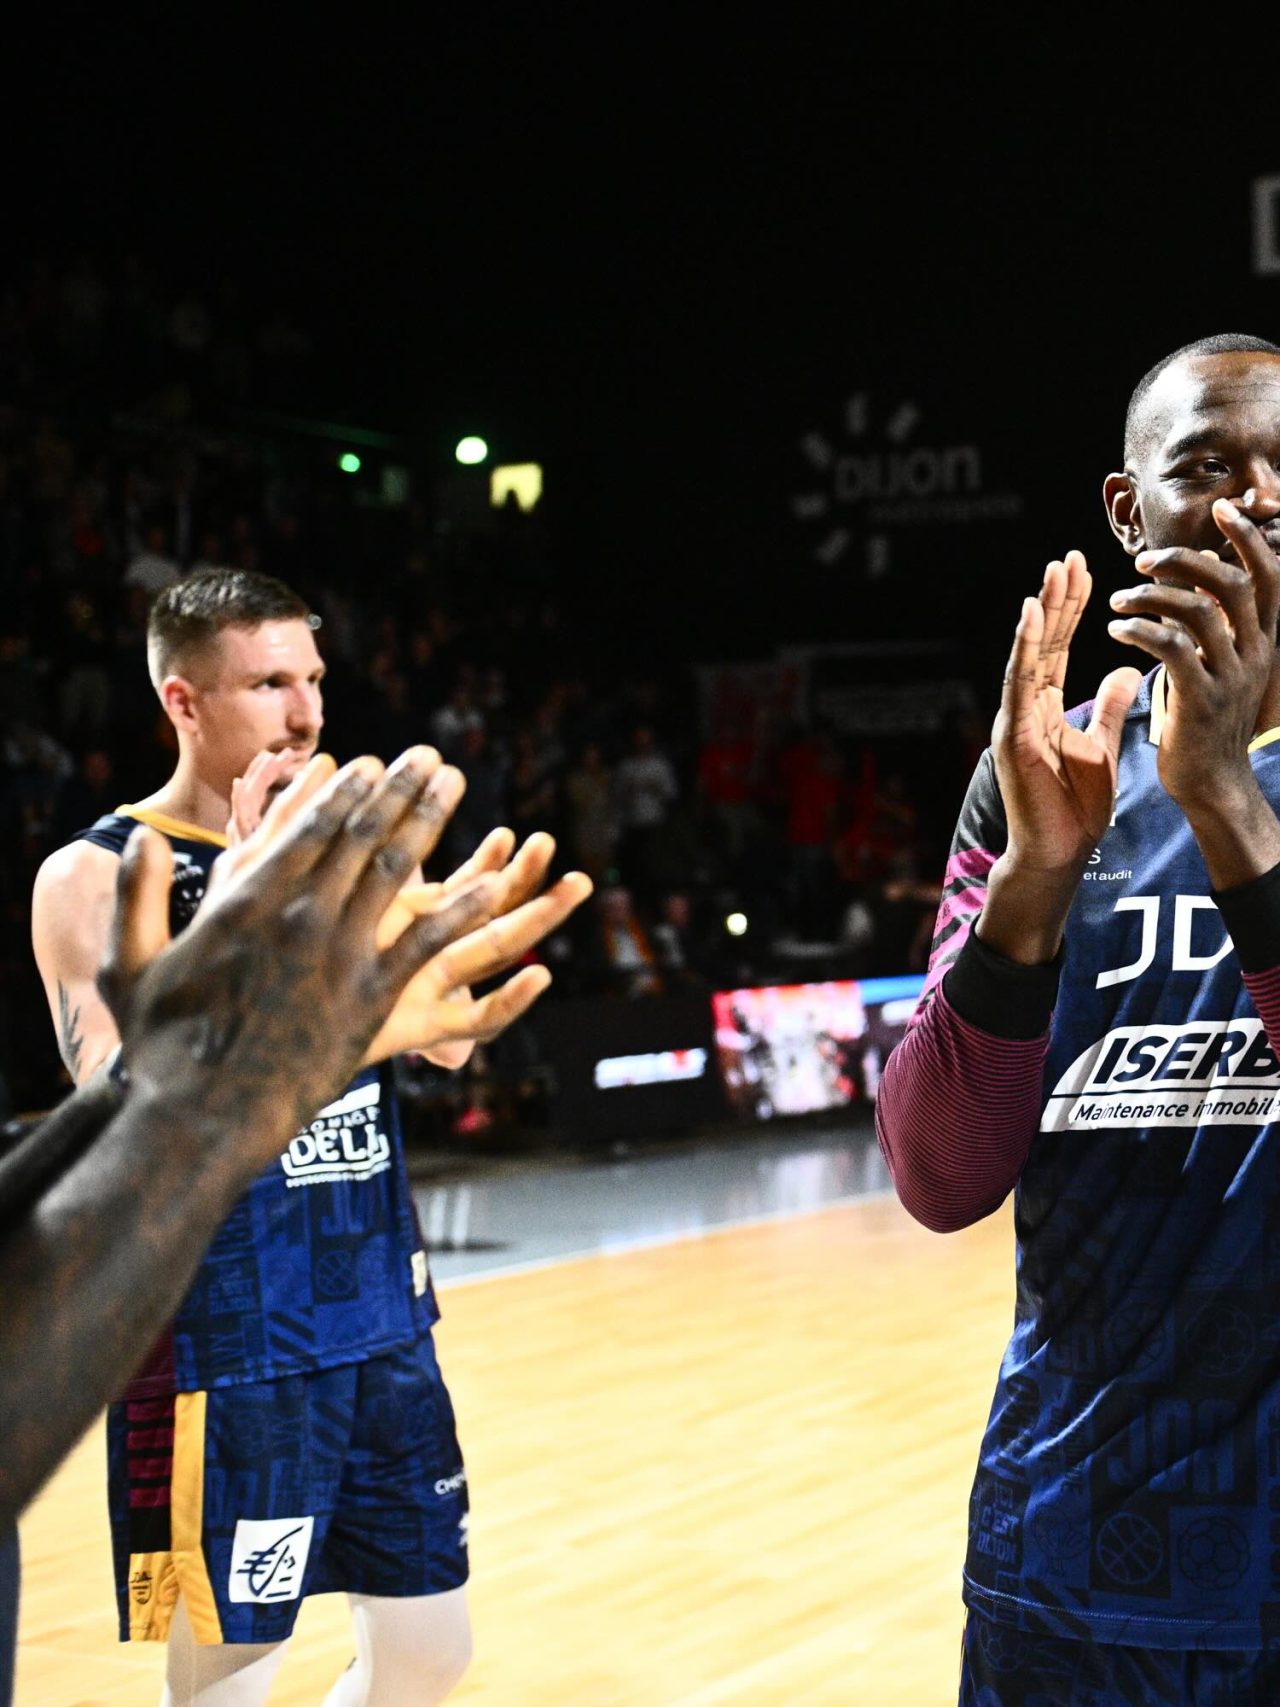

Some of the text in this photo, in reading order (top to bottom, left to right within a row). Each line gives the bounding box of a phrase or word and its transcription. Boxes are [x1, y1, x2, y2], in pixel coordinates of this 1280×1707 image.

[1083, 869, 1132, 880] et audit
[1096, 894, 1235, 989] JD
[1075, 1102, 1189, 1121] Maintenance
